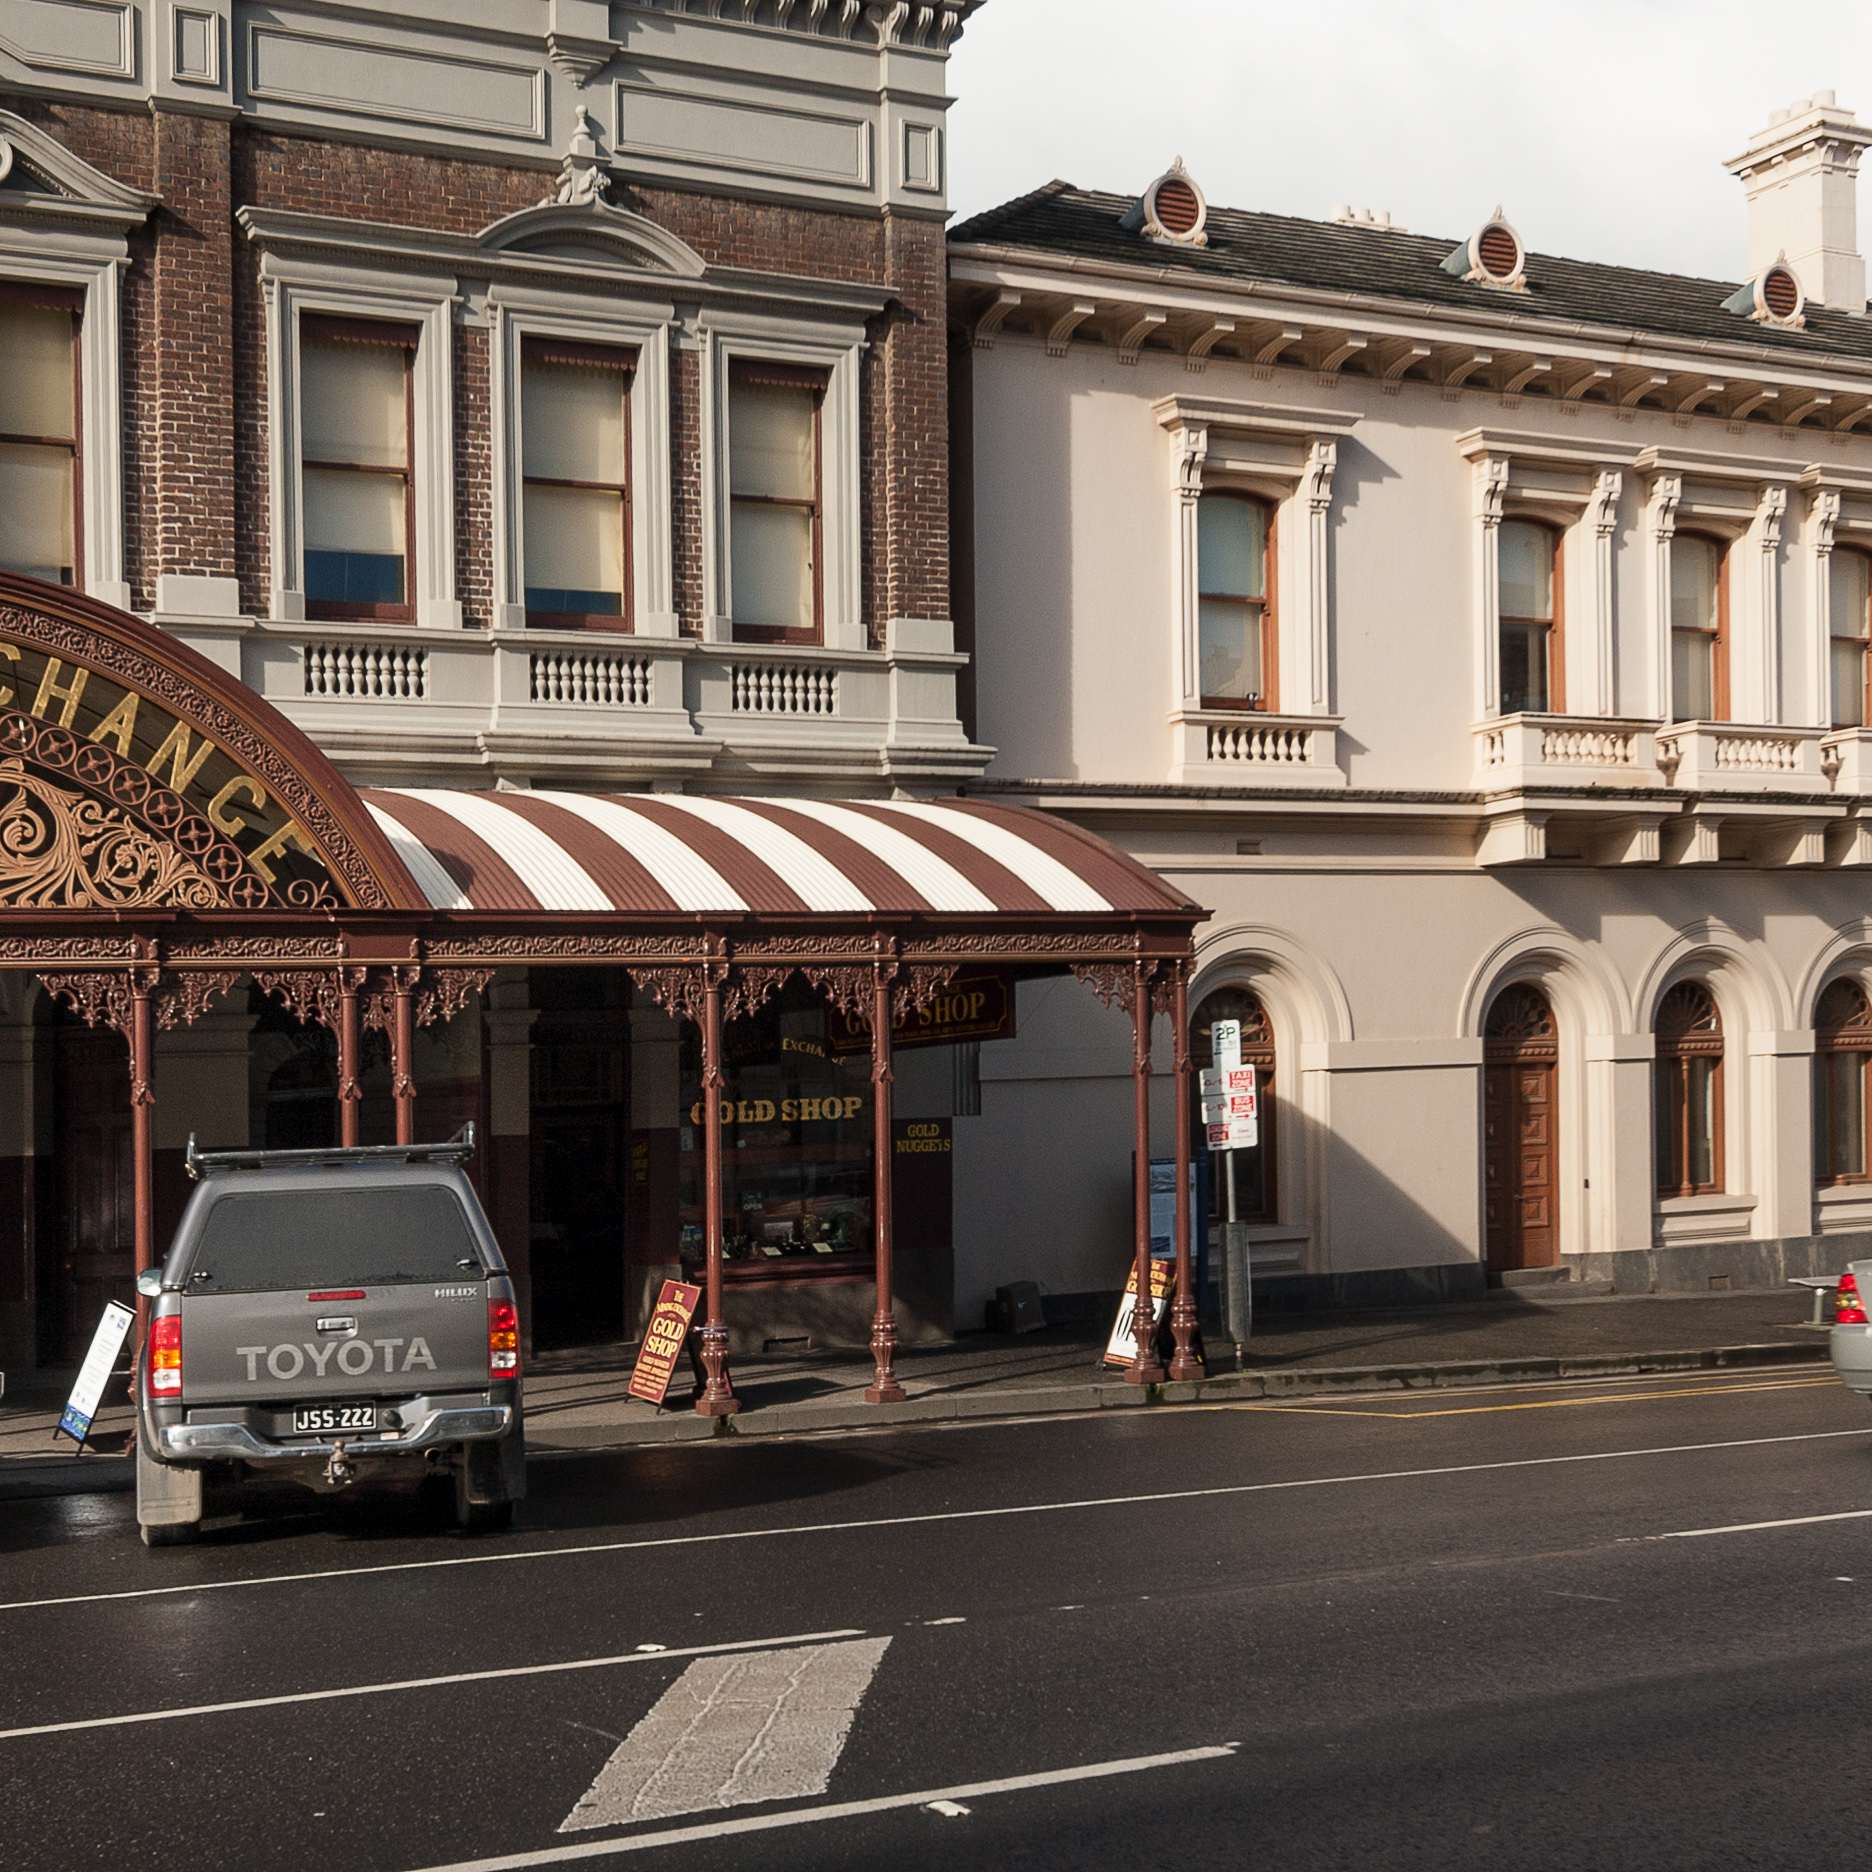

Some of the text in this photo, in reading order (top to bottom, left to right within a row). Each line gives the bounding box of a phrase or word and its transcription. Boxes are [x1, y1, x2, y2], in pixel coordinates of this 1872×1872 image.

[845, 1003, 908, 1035] GOD
[918, 991, 986, 1026] SHOP
[1215, 1026, 1236, 1041] 2P
[781, 1036, 847, 1068] EXCHAE
[690, 1095, 863, 1126] GOLD SHOP
[906, 1123, 940, 1138] GOLD
[896, 1139, 951, 1154] NUGGETS
[741, 1202, 764, 1212] OPEN
[434, 1287, 478, 1299] HILUX
[652, 1317, 685, 1341] GOLD
[235, 1336, 438, 1381] TOYOTA
[645, 1335, 678, 1359] SHOP
